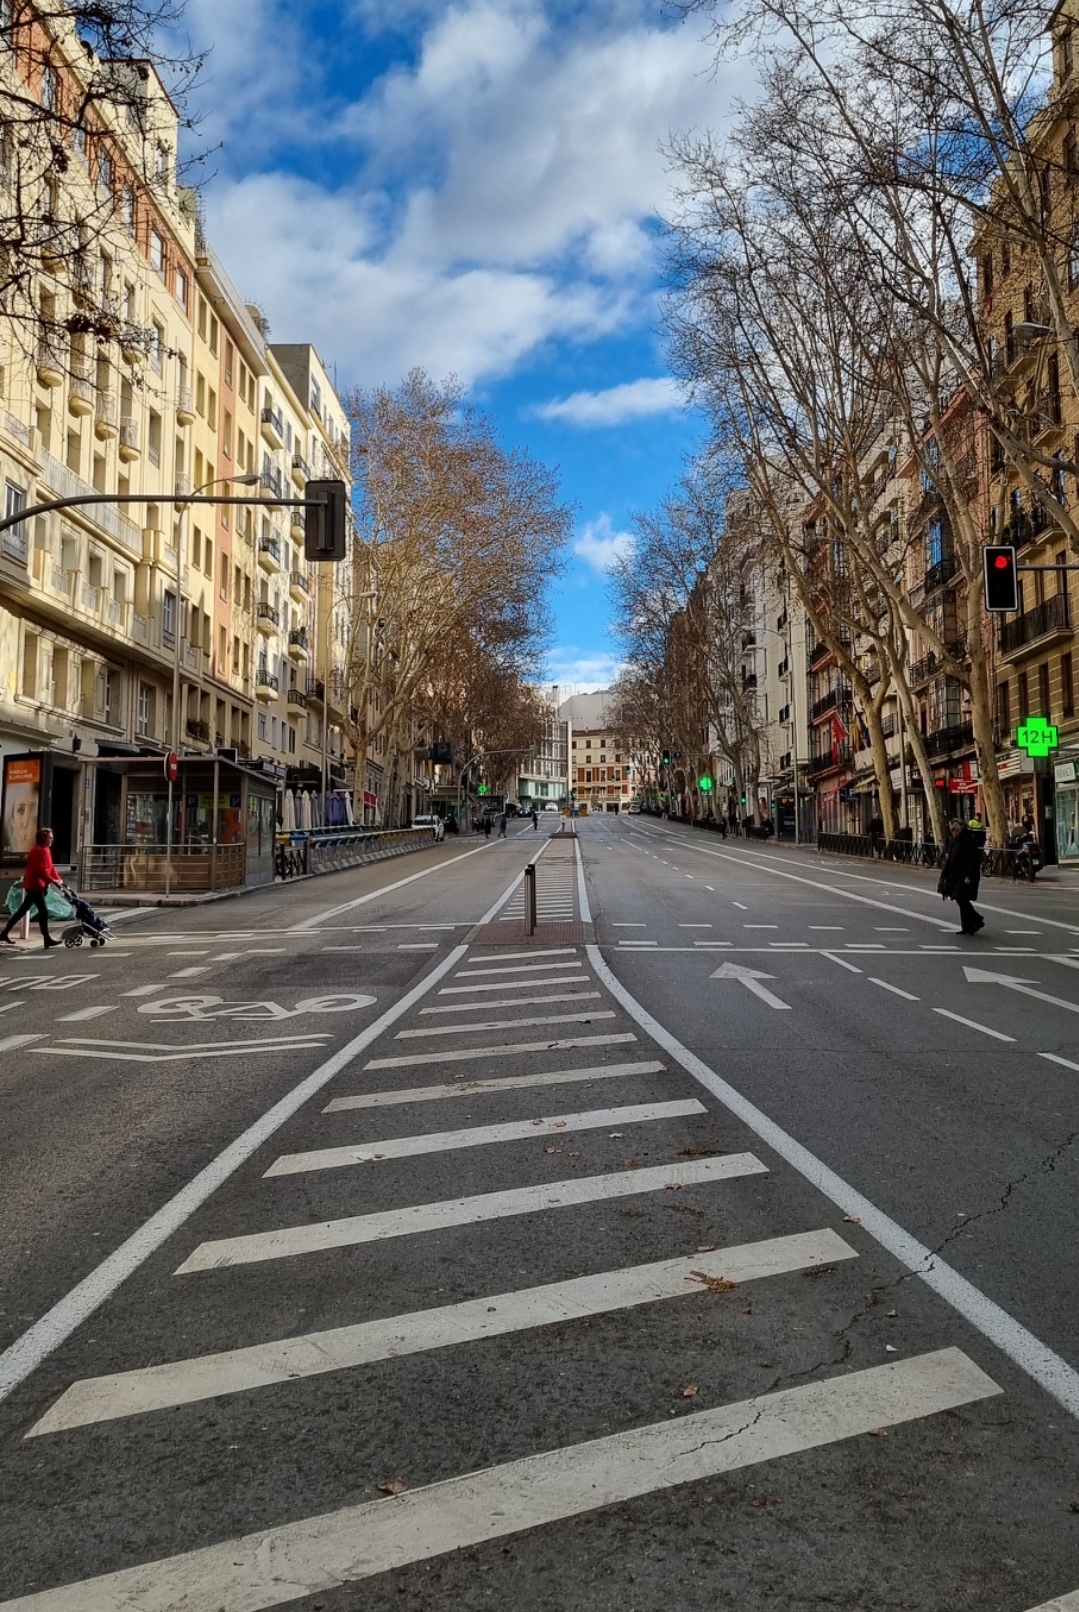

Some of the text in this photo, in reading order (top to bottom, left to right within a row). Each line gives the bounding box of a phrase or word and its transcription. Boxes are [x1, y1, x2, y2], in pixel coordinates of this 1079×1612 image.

[1022, 729, 1054, 744] 12H
[438, 744, 448, 757] P
[188, 797, 196, 806] P
[0, 973, 102, 991] BU
